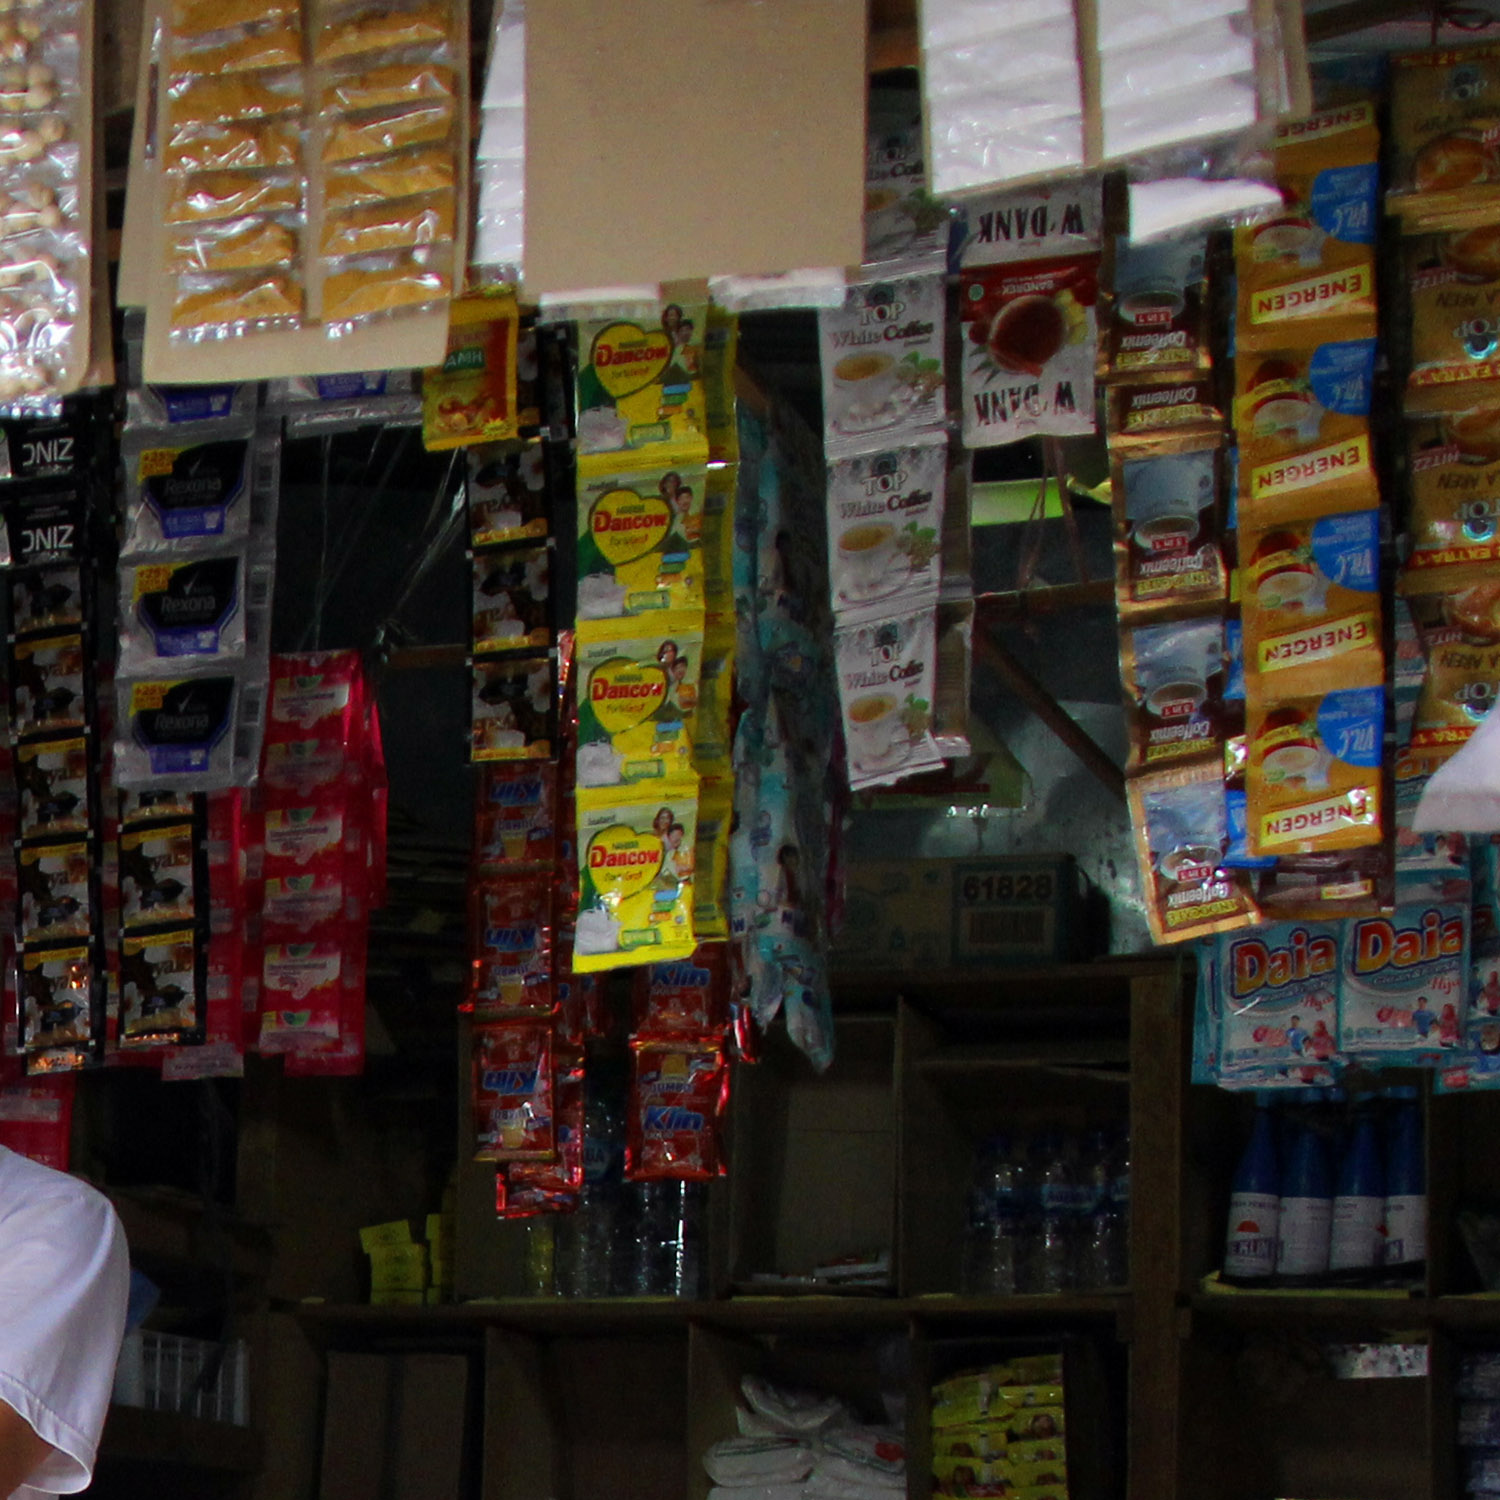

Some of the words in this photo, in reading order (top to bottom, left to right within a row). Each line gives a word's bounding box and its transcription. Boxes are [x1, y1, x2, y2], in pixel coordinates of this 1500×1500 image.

[1257, 275, 1362, 312] ENERGEN
[858, 302, 904, 325] TOP
[596, 346, 670, 367] Dancow
[1257, 446, 1361, 487] ENERGEN
[594, 511, 668, 532] Dancow
[1264, 622, 1368, 662] ENERGEN
[592, 678, 664, 700] Dancow
[590, 845, 661, 868] Dancow
[1356, 910, 1462, 974] Daia
[1234, 929, 1336, 996] Daia
